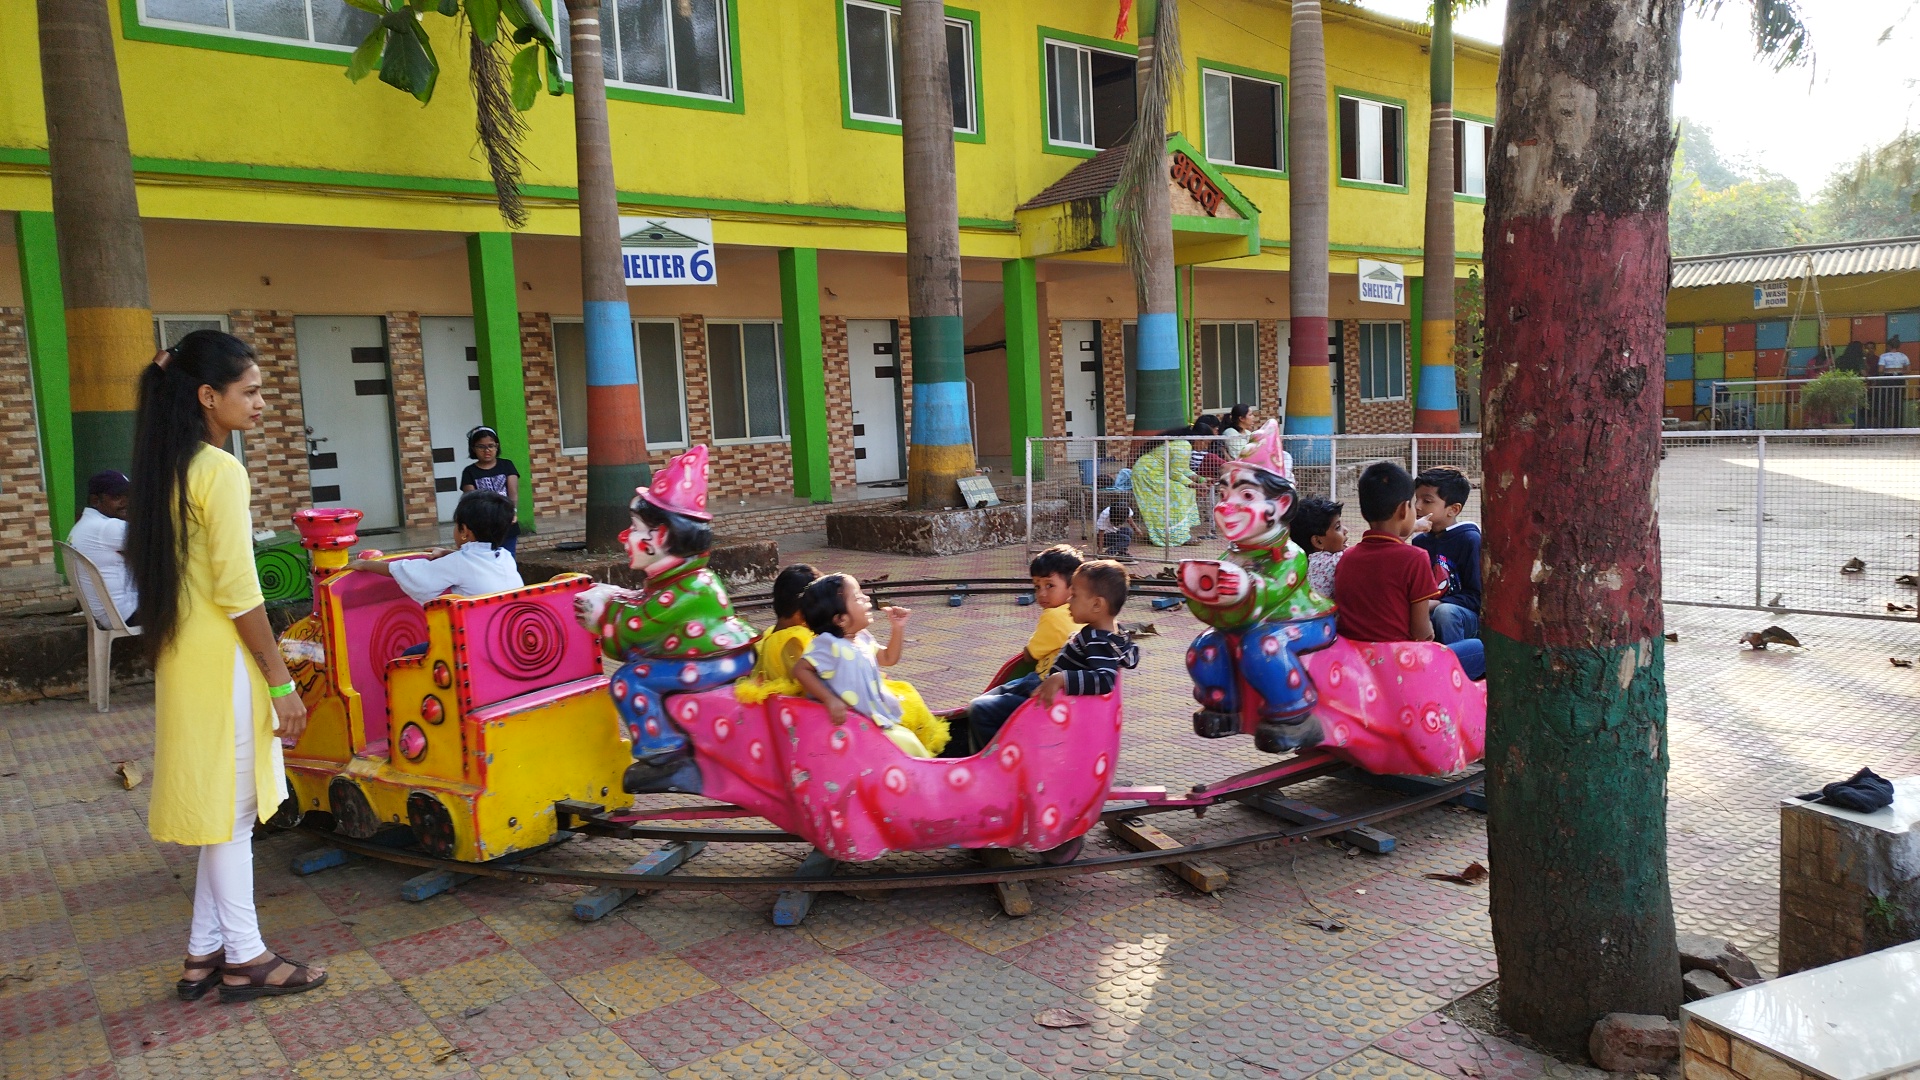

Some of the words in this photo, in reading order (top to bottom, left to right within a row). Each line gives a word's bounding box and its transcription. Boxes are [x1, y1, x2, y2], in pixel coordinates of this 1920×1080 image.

[1170, 149, 1225, 217] भवन
[623, 255, 686, 279] ELTER
[689, 249, 714, 282] 6
[1362, 282, 1393, 300] SHELTER
[1394, 283, 1403, 303] 7
[1763, 282, 1788, 290] LADIES
[1765, 290, 1787, 298] WASH
